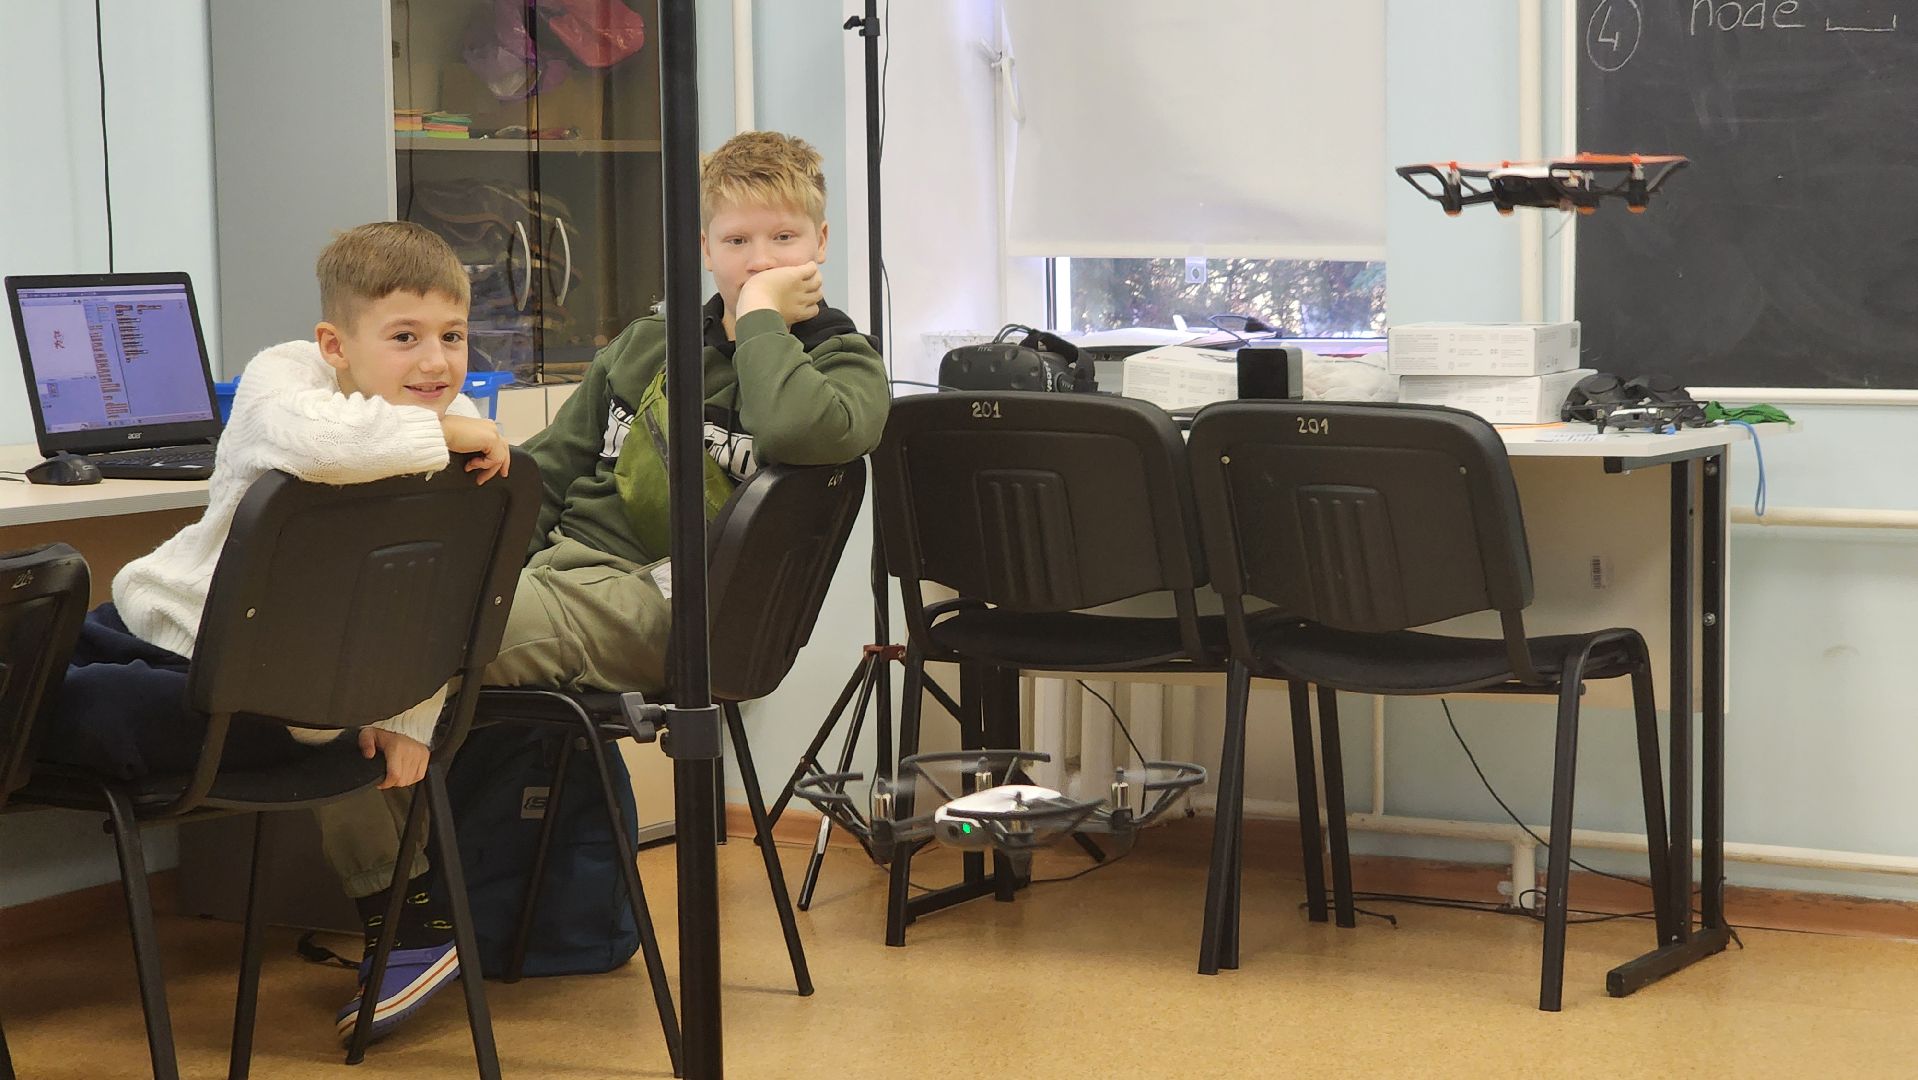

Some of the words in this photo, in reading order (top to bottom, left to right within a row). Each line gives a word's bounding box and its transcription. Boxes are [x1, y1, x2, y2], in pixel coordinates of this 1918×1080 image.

[1597, 5, 1619, 52] 4
[971, 401, 1002, 419] 201
[1296, 416, 1329, 435] 201
